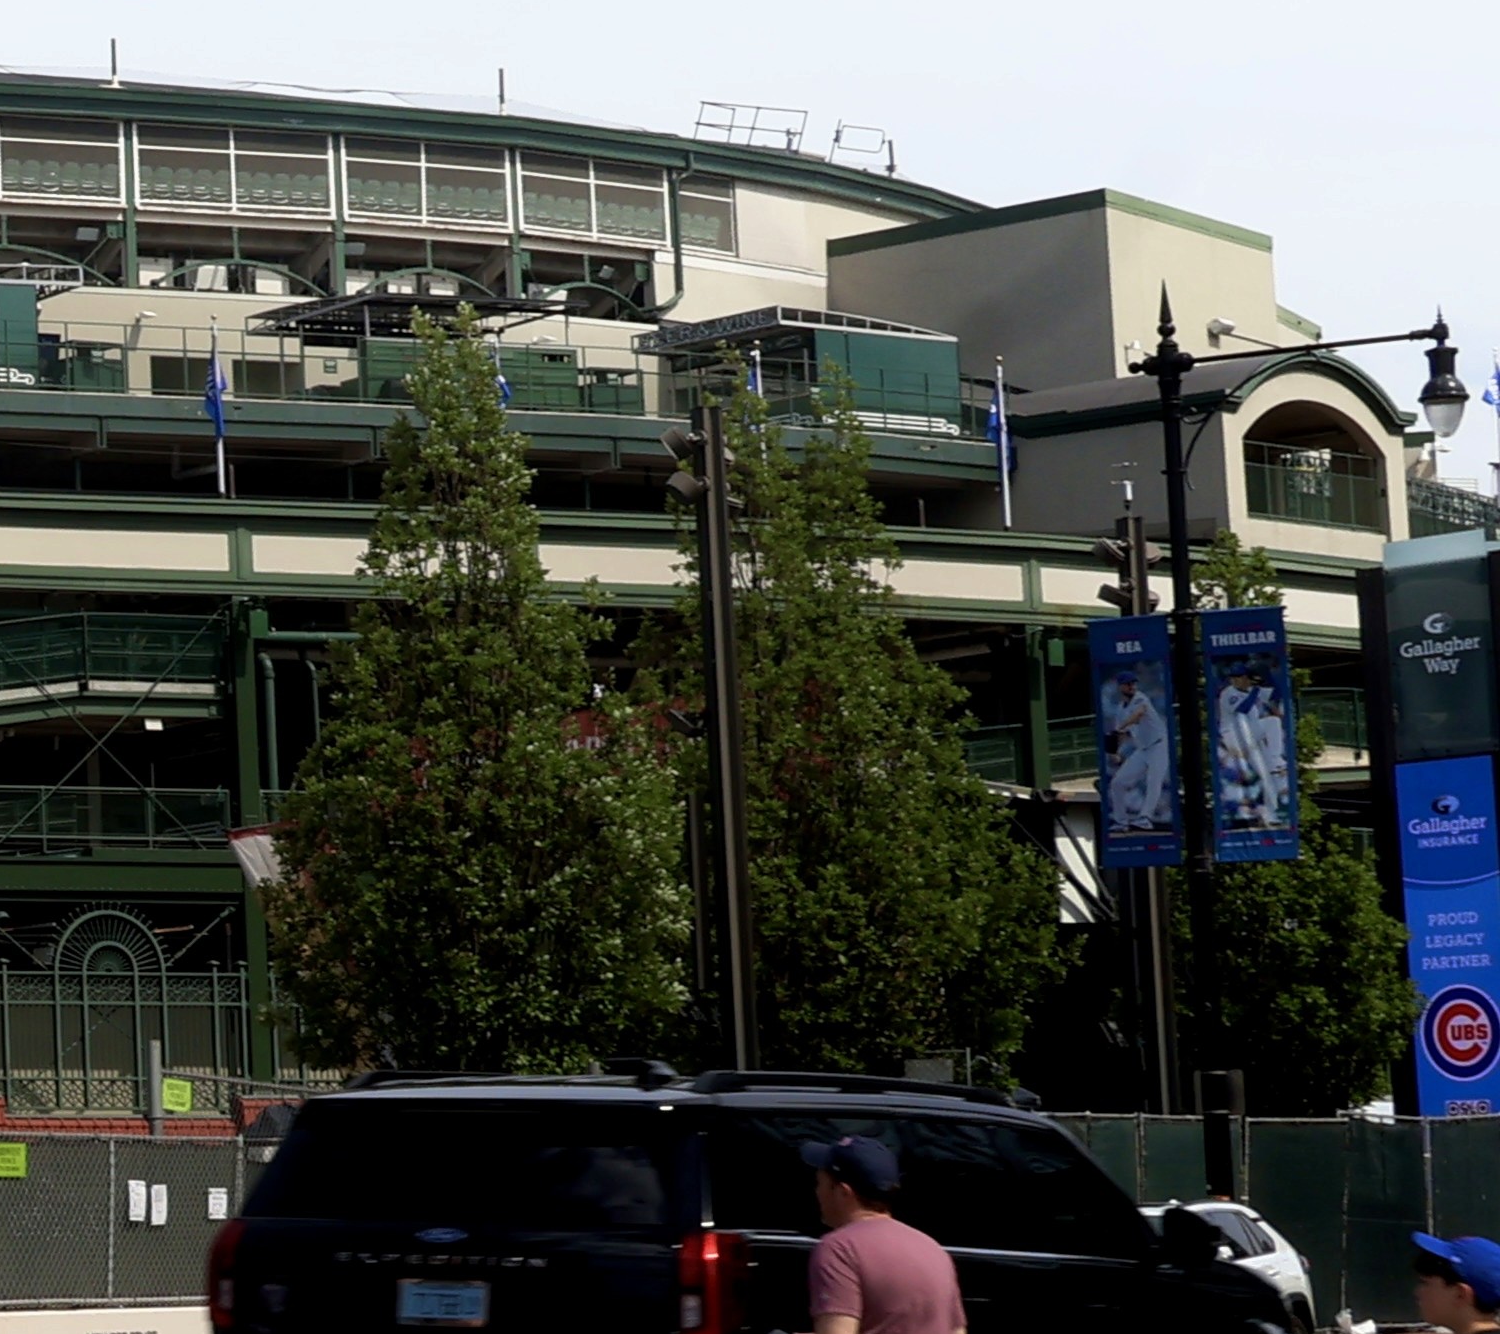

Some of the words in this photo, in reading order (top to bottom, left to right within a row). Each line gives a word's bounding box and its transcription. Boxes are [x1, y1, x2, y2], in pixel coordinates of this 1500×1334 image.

[1115, 640, 1143, 654] REA
[1209, 630, 1276, 647] THIELBAR
[1399, 635, 1481, 658] Gallagher
[1422, 657, 1460, 675] Way
[1407, 816, 1488, 835] Gallagher
[1417, 833, 1479, 849] INSURANCE
[1427, 911, 1479, 927] PROUD
[1424, 932, 1485, 949] LEGACY
[1421, 953, 1492, 970] PARTNER
